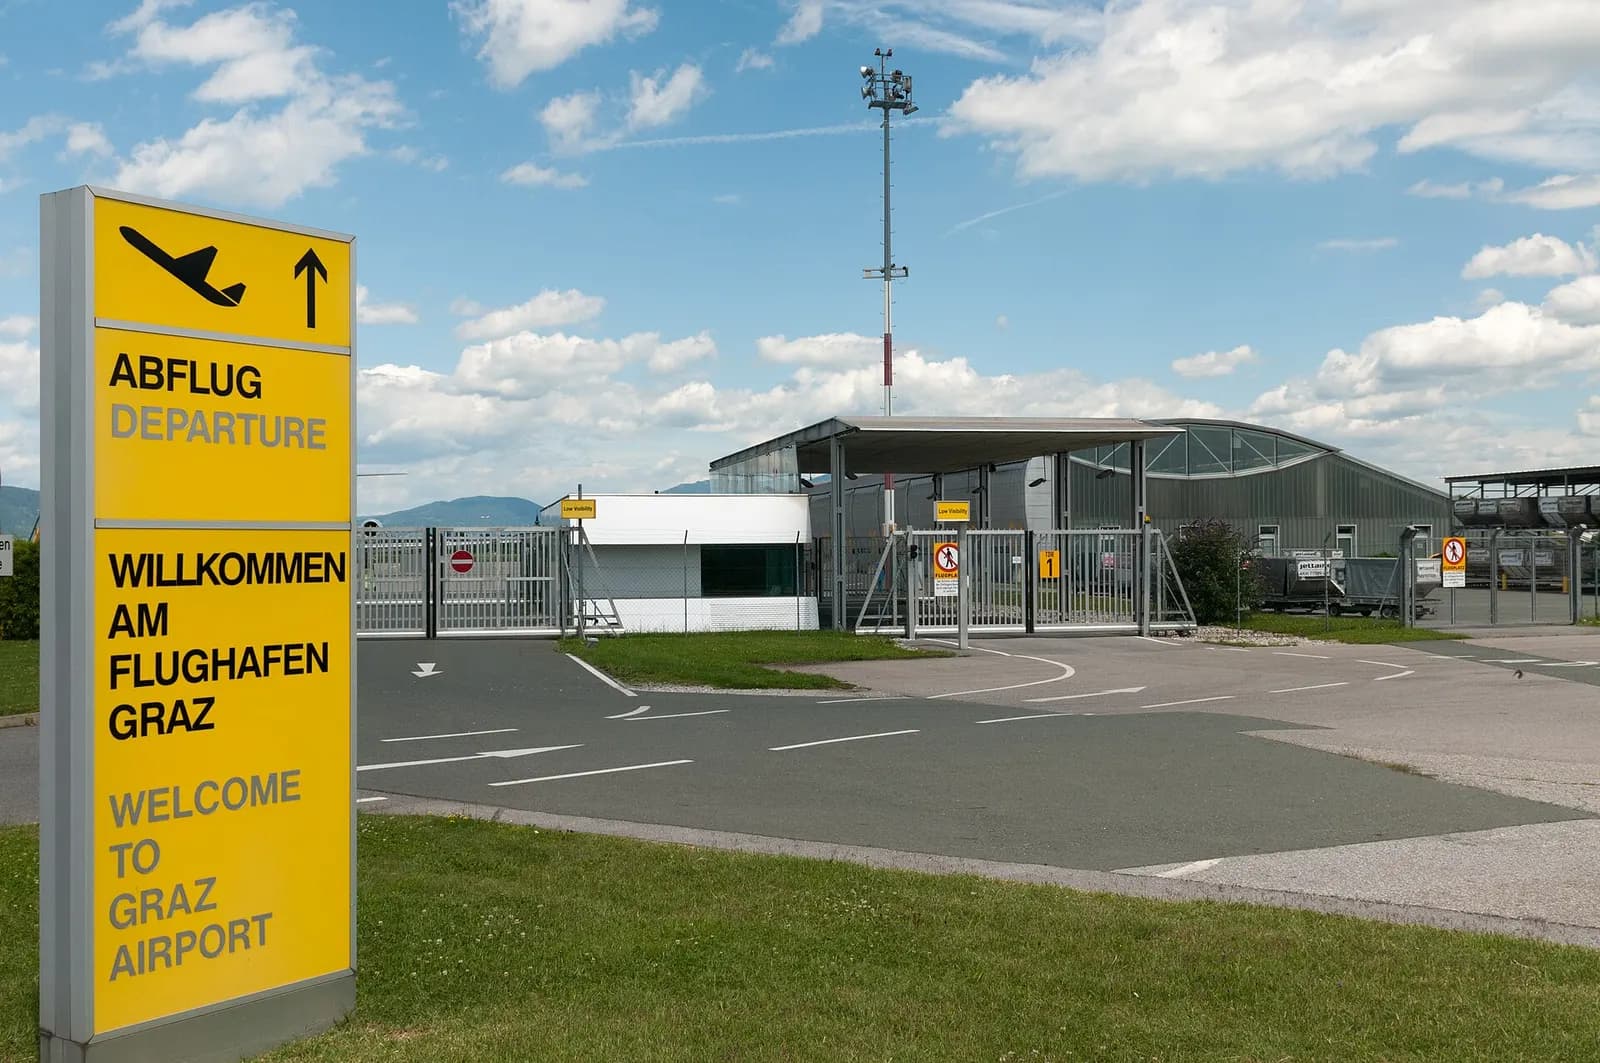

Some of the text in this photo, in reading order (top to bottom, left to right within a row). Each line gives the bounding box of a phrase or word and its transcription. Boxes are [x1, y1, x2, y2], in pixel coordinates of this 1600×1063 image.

[109, 353, 262, 399] ABFLUG
[111, 403, 327, 450] DEPARTURE
[108, 551, 346, 588] WILLKOMMEN
[1046, 558, 1053, 576] 1
[107, 602, 169, 639] AM
[110, 642, 329, 690] FLUGHAFEN
[108, 696, 216, 741] GRAZ
[109, 769, 301, 828] WELCOME
[109, 838, 161, 878] TO
[109, 877, 217, 930] GRAZ
[109, 912, 273, 982] AIRPORT
